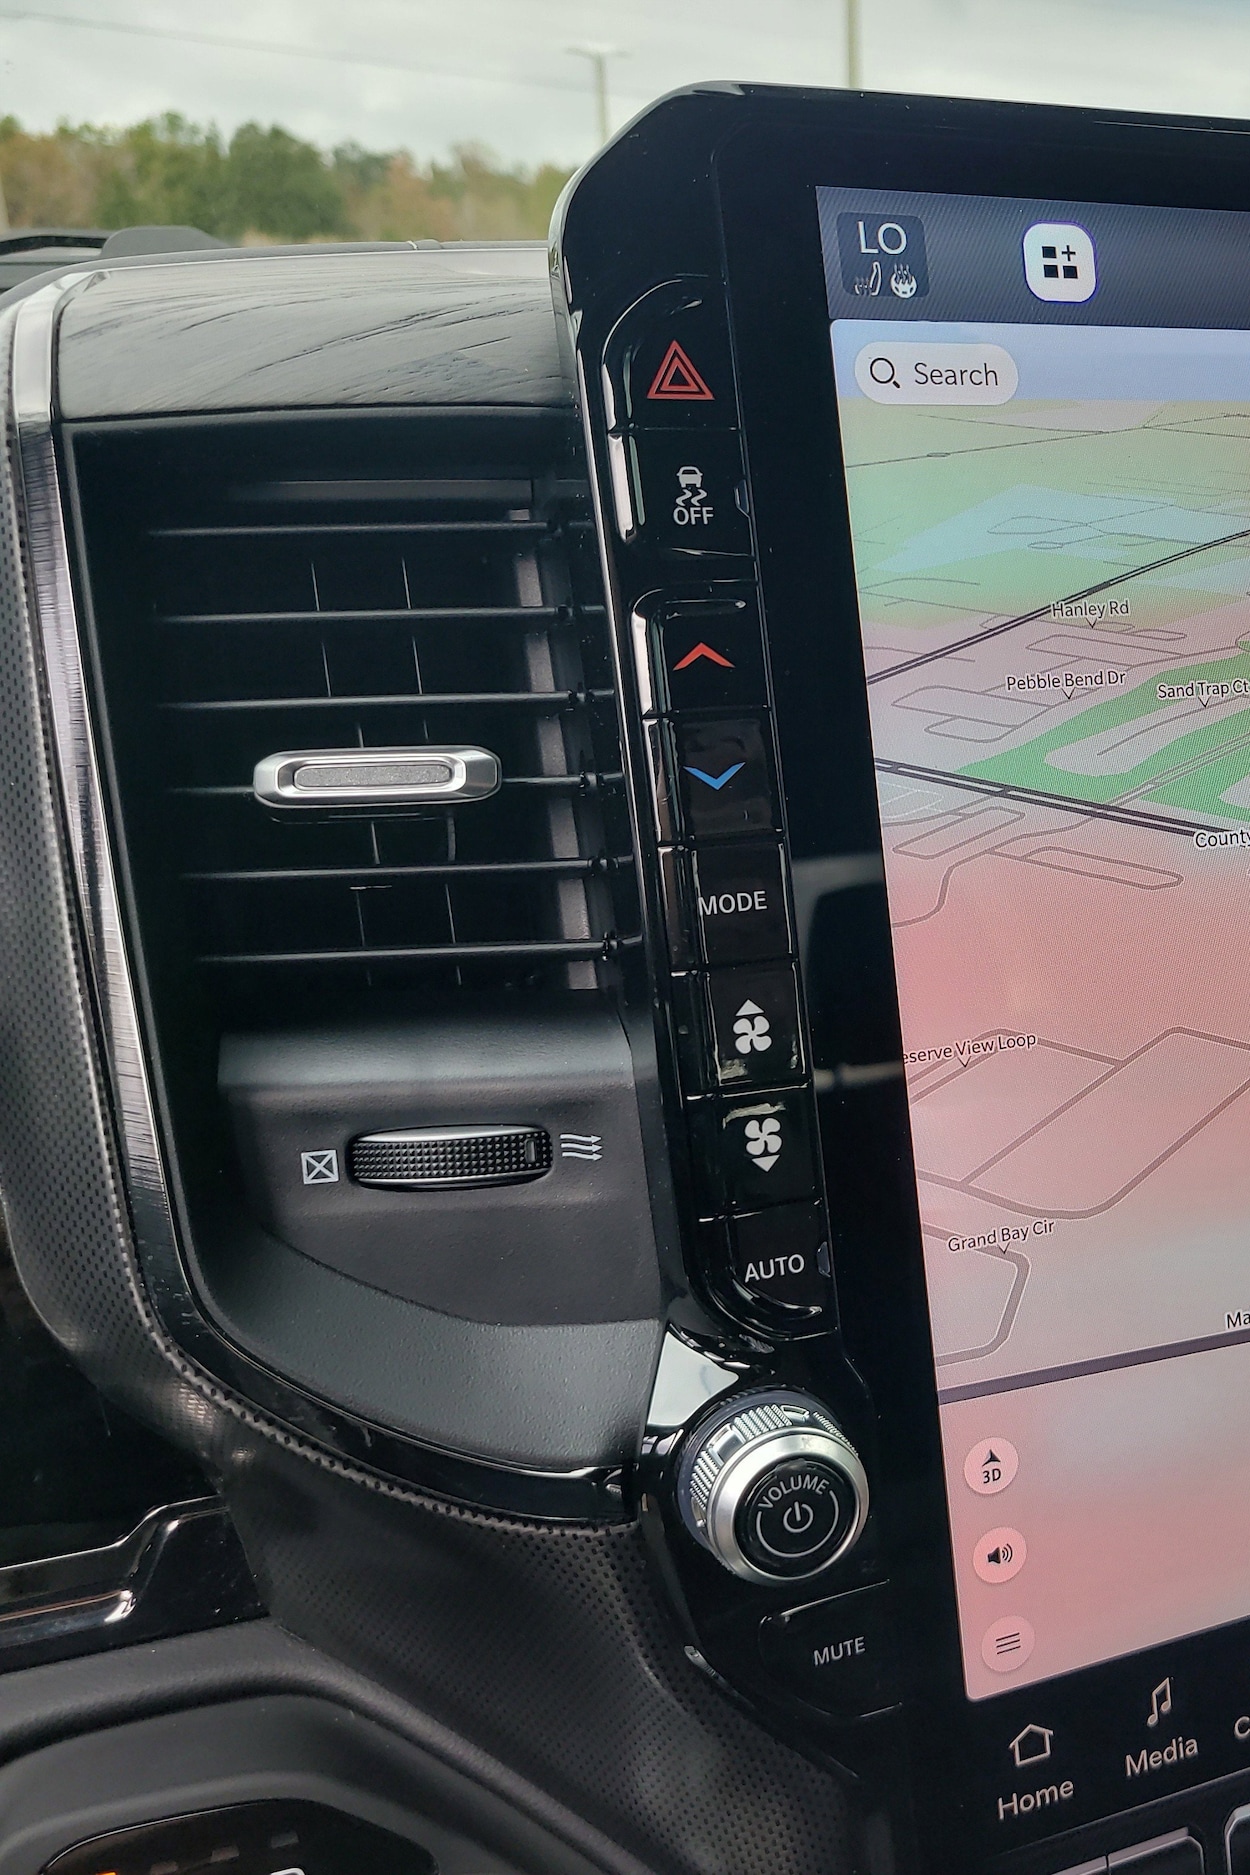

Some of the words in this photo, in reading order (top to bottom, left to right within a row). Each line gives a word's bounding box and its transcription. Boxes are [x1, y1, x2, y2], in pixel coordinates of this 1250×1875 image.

[857, 221, 907, 255] LO
[914, 362, 999, 387] Search
[673, 506, 714, 525] OFF
[1052, 602, 1105, 619] Hanley
[1110, 600, 1129, 615] Rd
[1007, 674, 1061, 690] Pebble
[1065, 671, 1104, 687] Bend
[1108, 671, 1126, 685] Dr
[1158, 683, 1194, 699] Sand
[1198, 681, 1229, 697] Trap
[1233, 680, 1249, 694] Ct
[699, 891, 768, 917] MODE
[955, 1041, 995, 1056] View
[998, 1034, 1037, 1051] Loop
[948, 1232, 997, 1252] Grand
[1001, 1224, 1031, 1243] Bay
[1033, 1219, 1055, 1235] Cir
[744, 1253, 805, 1283] AUTO
[982, 1468, 1001, 1484] 3D
[757, 1474, 830, 1510] VOLUME
[813, 1636, 867, 1667] MUTE
[1125, 1736, 1200, 1778] Media
[997, 1779, 1075, 1821] Home
